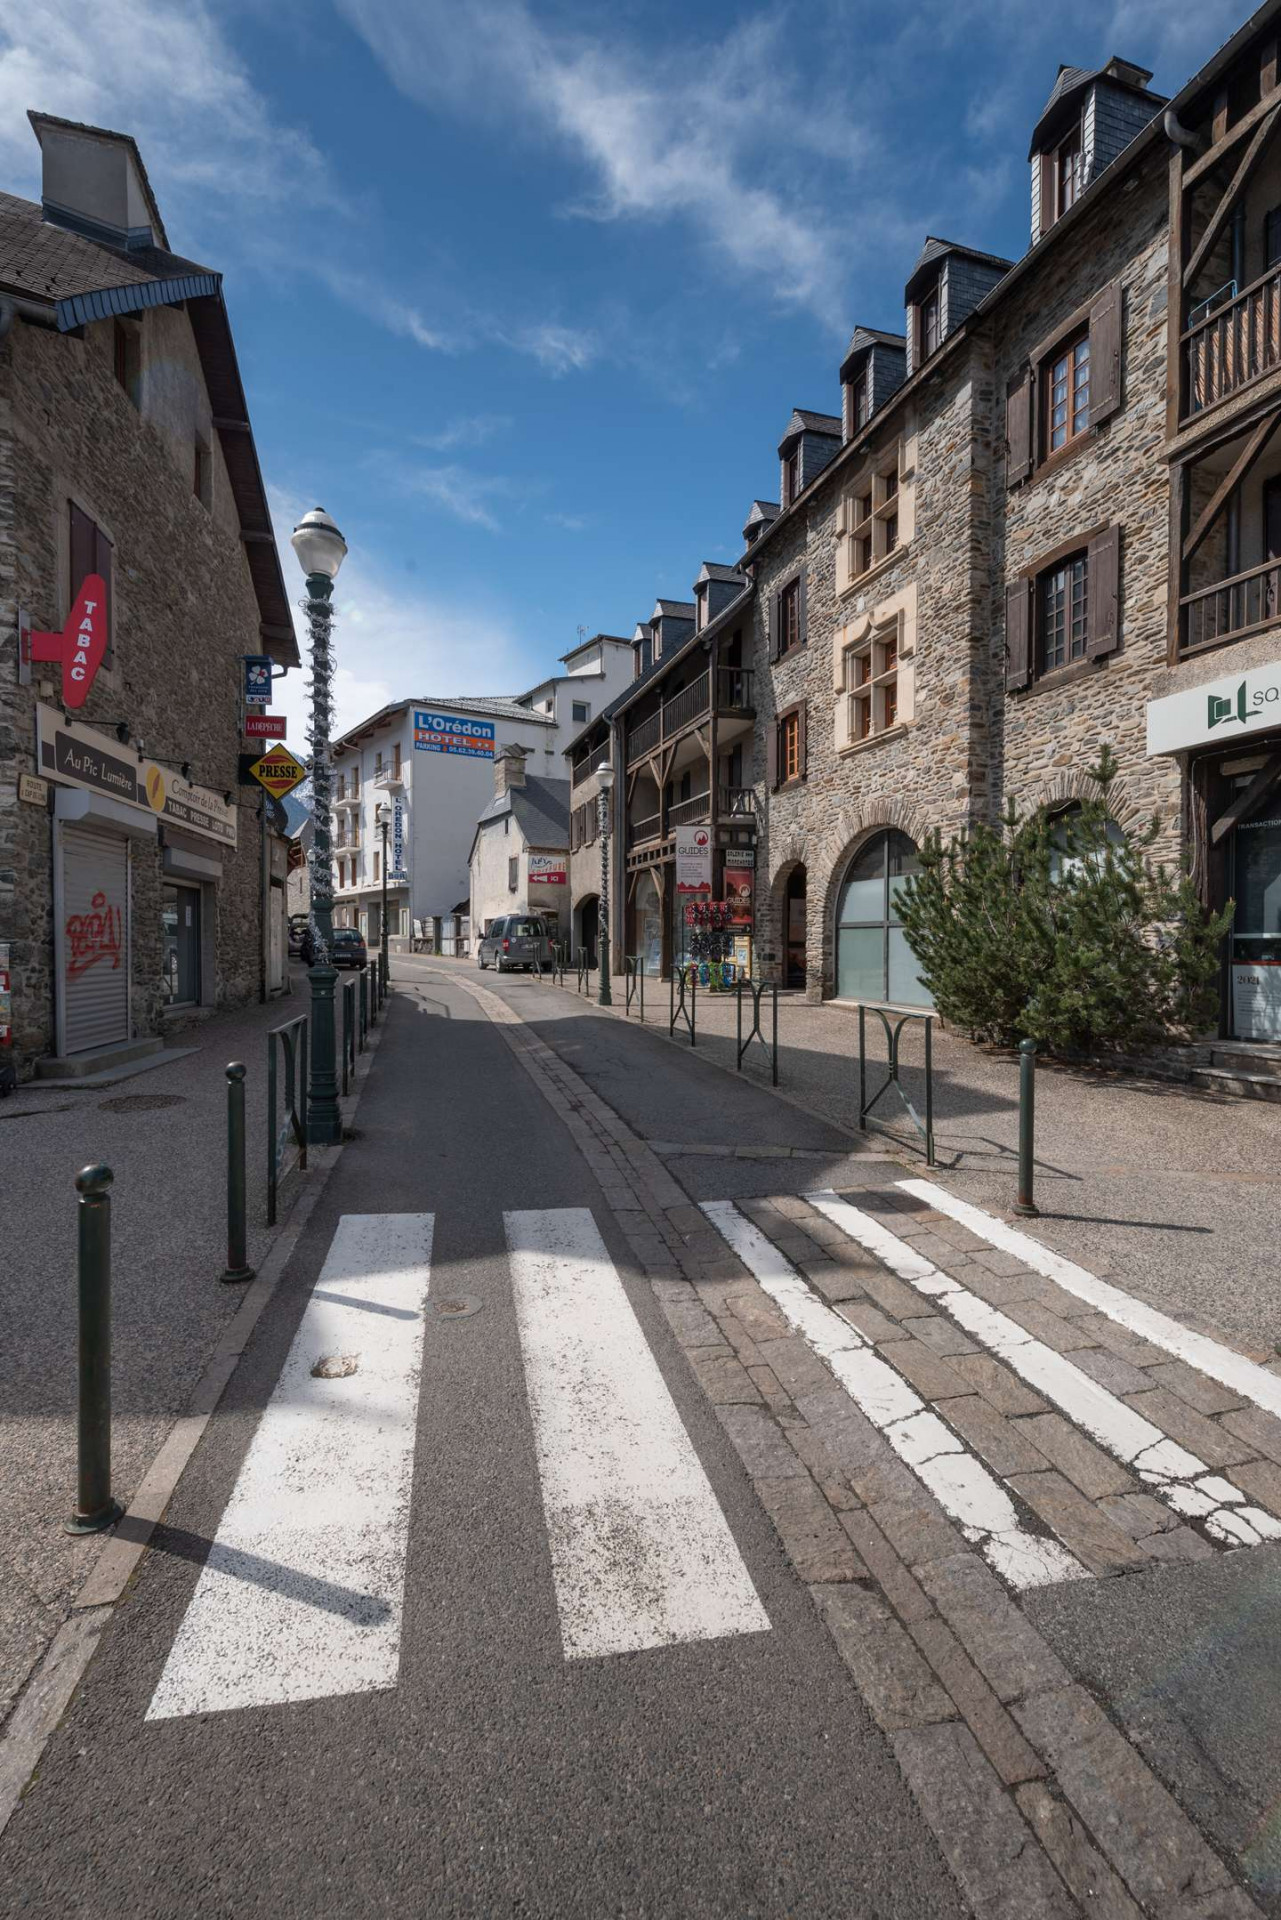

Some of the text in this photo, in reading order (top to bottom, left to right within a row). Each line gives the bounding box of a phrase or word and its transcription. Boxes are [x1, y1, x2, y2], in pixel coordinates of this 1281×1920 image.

[71, 600, 97, 681] TABAC
[416, 742, 441, 751] PARKING
[64, 748, 132, 791] Au Pic Lumière
[258, 764, 298, 779] PRESSE
[168, 800, 187, 819] TABAC
[190, 810, 209, 828] PRESSE
[394, 843, 402, 870] HOTEL
[678, 847, 709, 855] GUIDES
